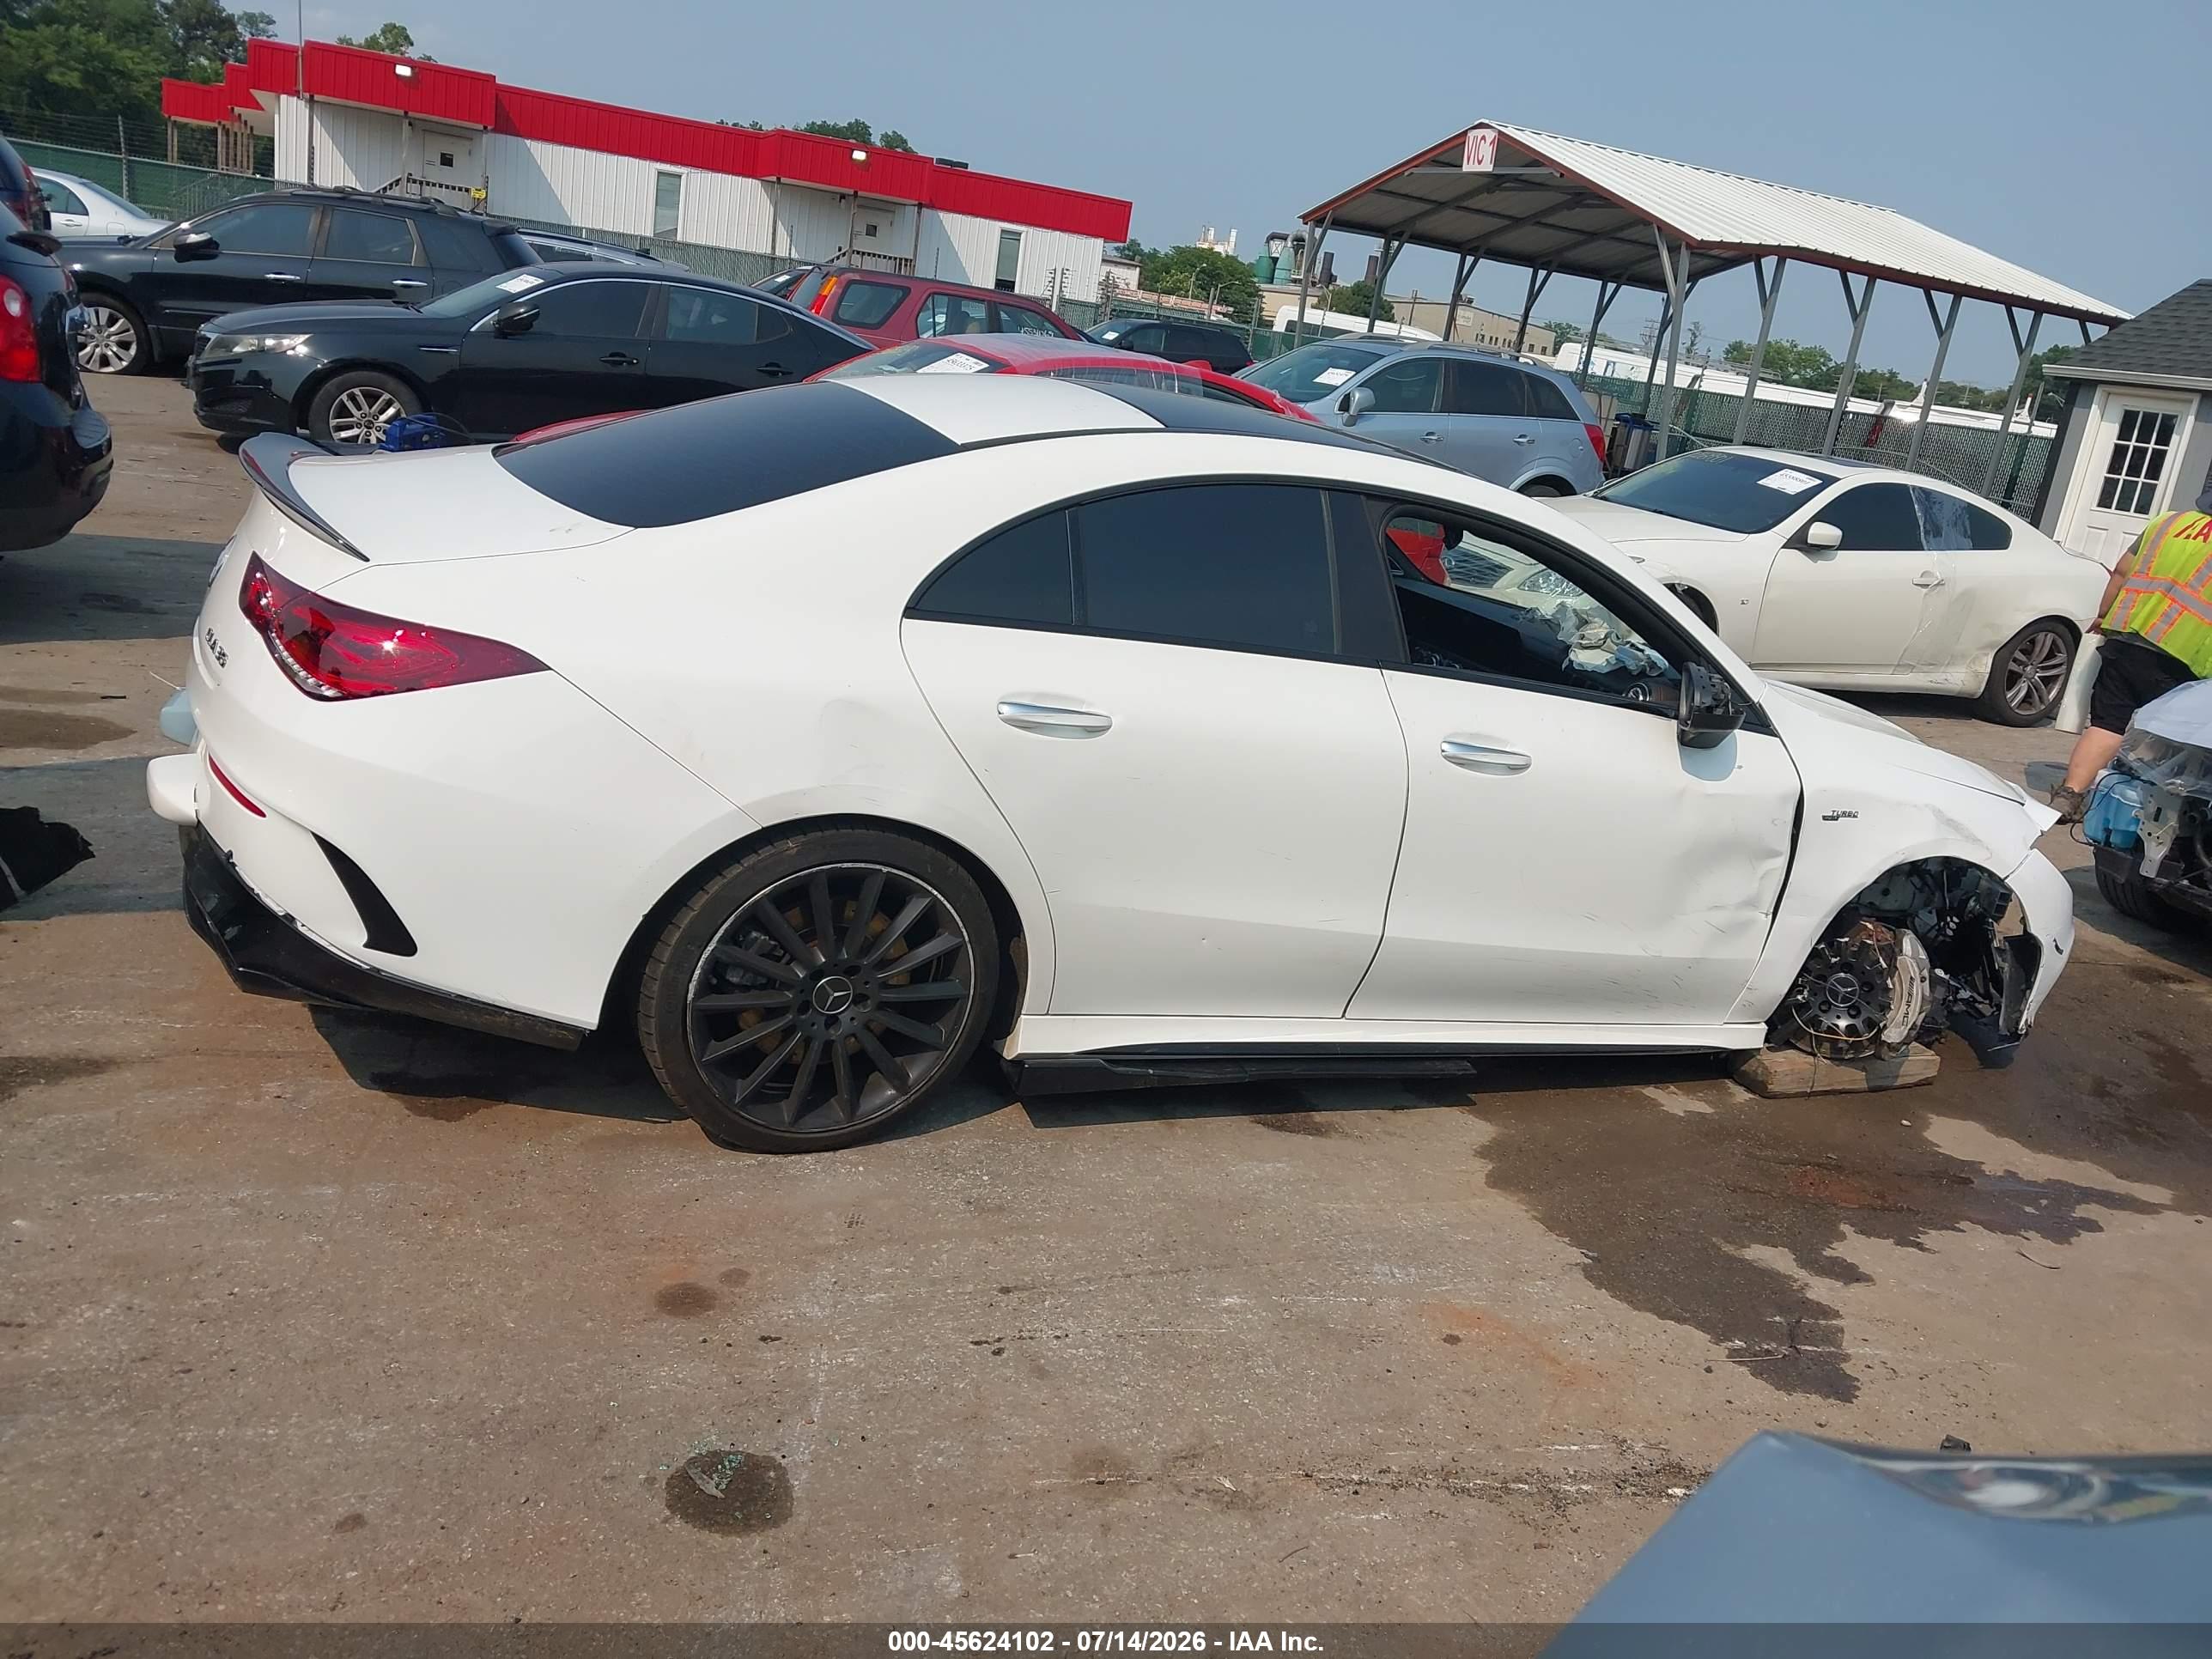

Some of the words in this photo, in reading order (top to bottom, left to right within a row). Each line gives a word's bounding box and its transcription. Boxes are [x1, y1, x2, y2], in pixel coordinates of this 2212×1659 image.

[1467, 134, 1486, 166] VIC
[1489, 134, 1497, 166] 1
[1831, 810, 1859, 818] TURBO
